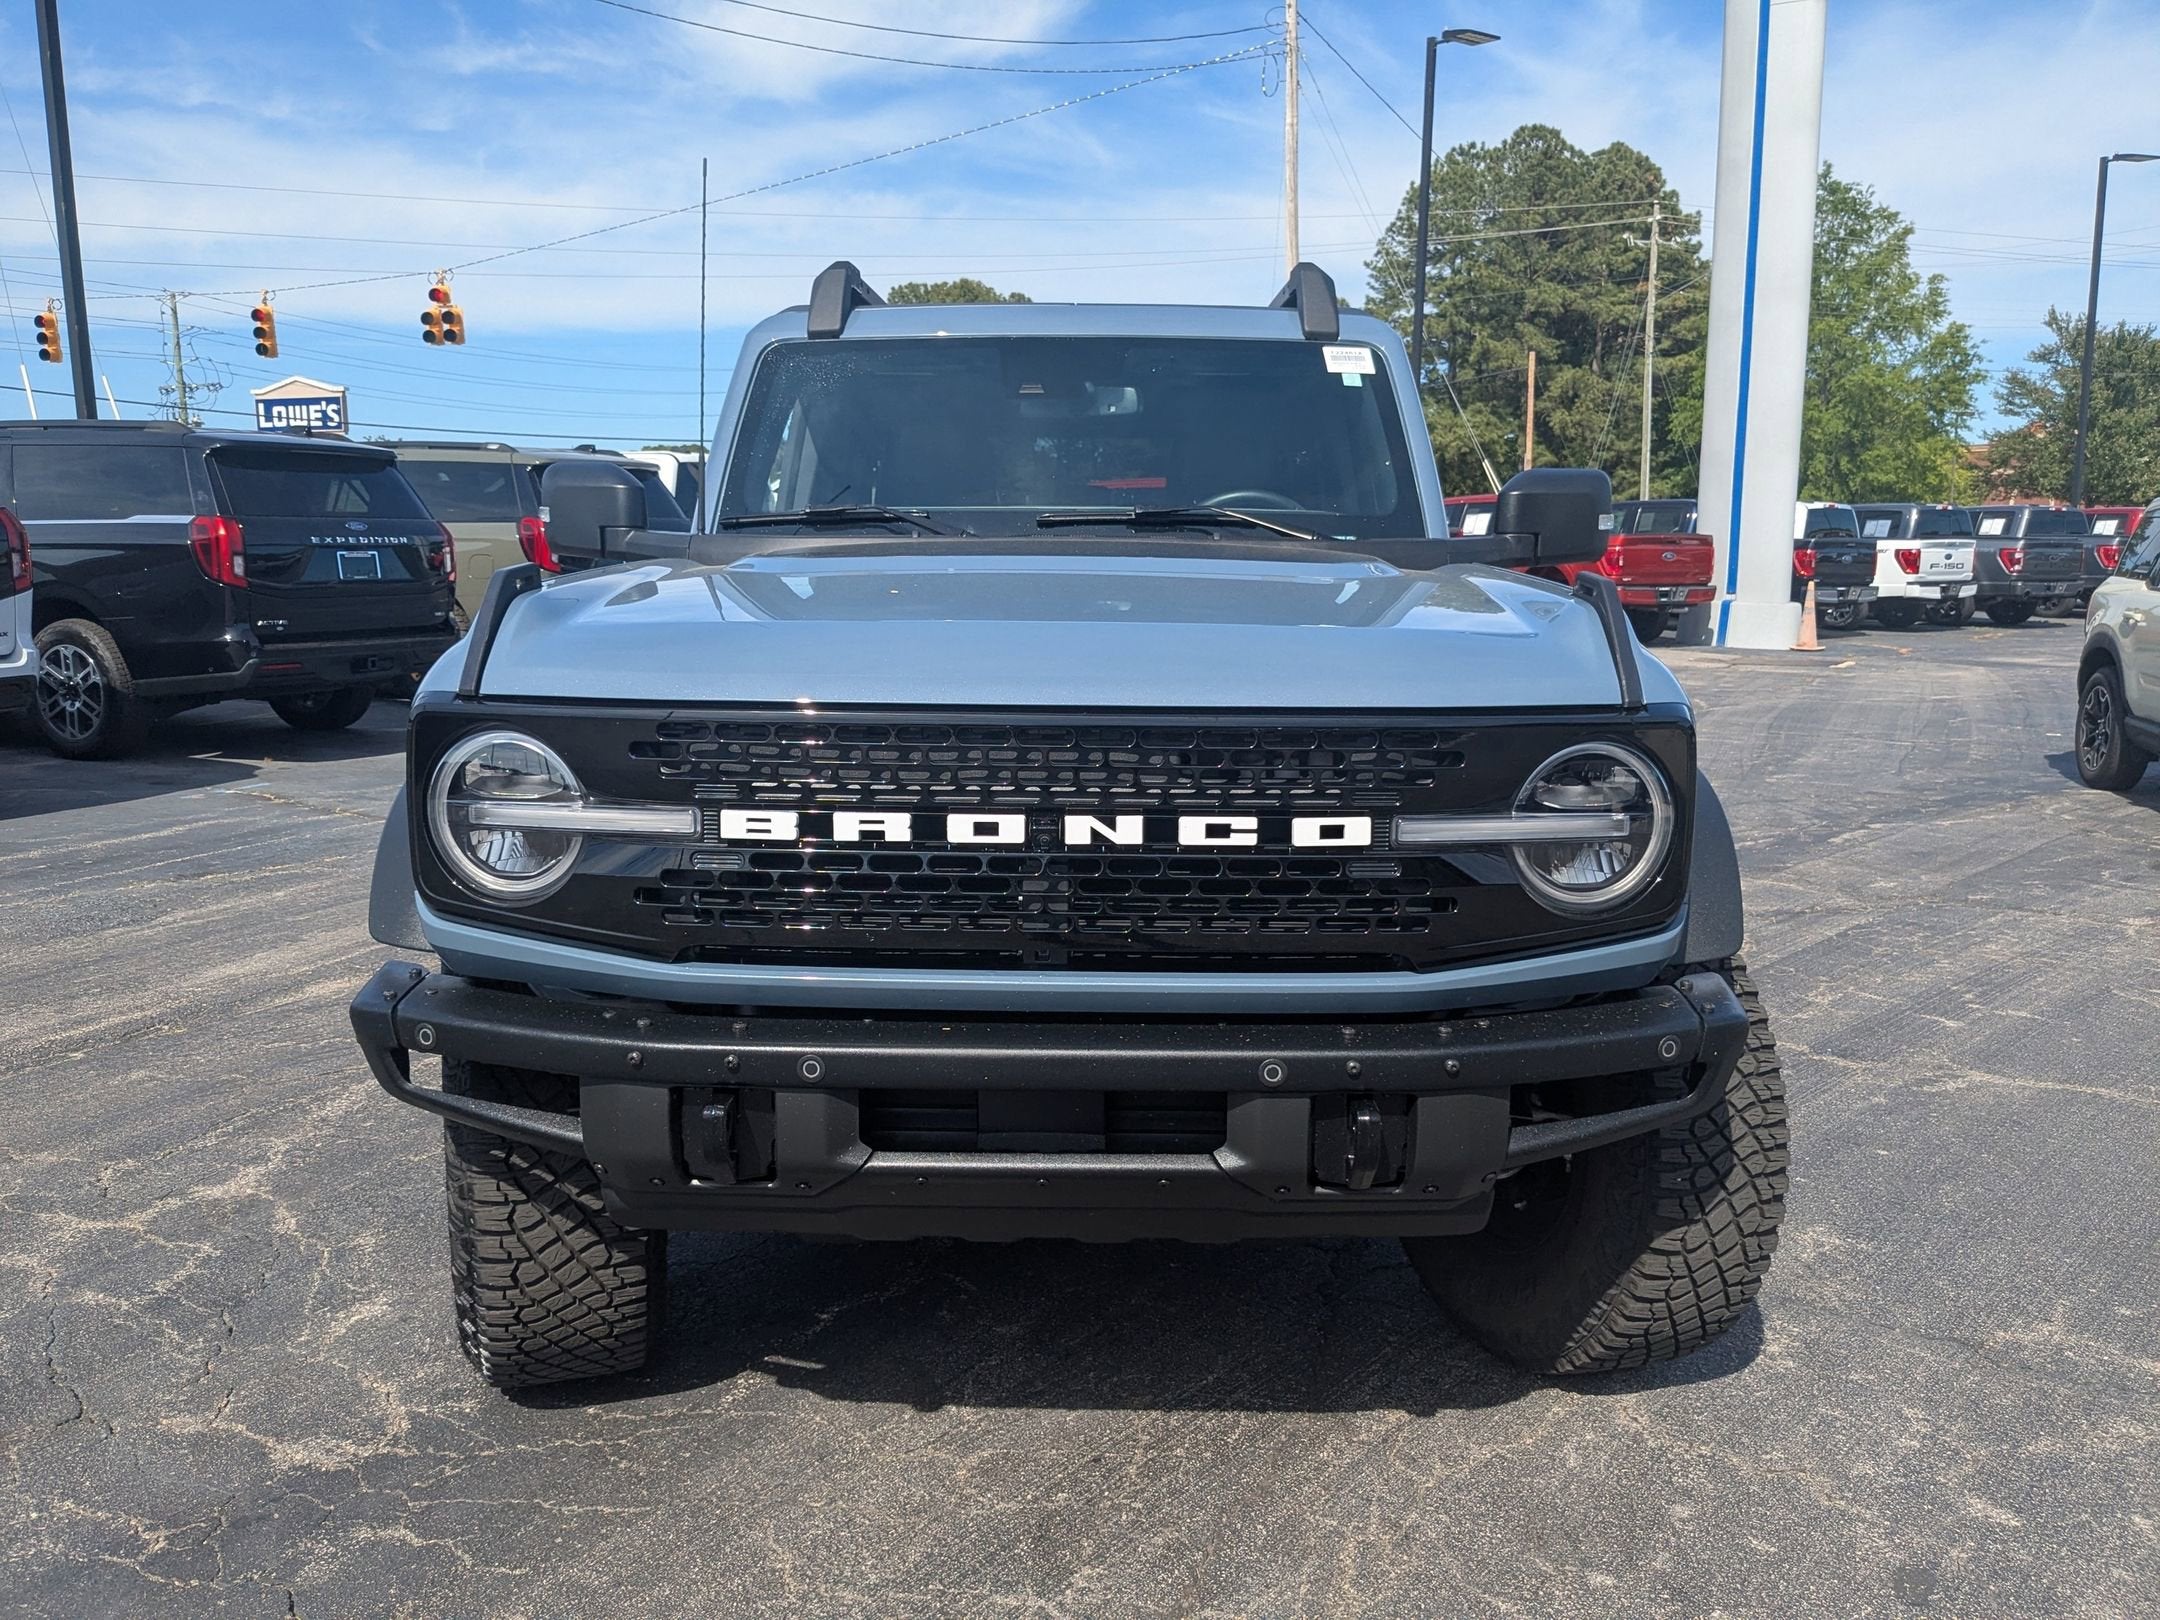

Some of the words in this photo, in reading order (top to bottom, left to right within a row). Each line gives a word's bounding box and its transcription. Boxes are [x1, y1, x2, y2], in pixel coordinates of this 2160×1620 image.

[257, 401, 340, 428] LOWE'S
[310, 536, 408, 544] EXPEDITION
[1929, 562, 1965, 570] F-150
[720, 809, 1372, 847] BRONCO
